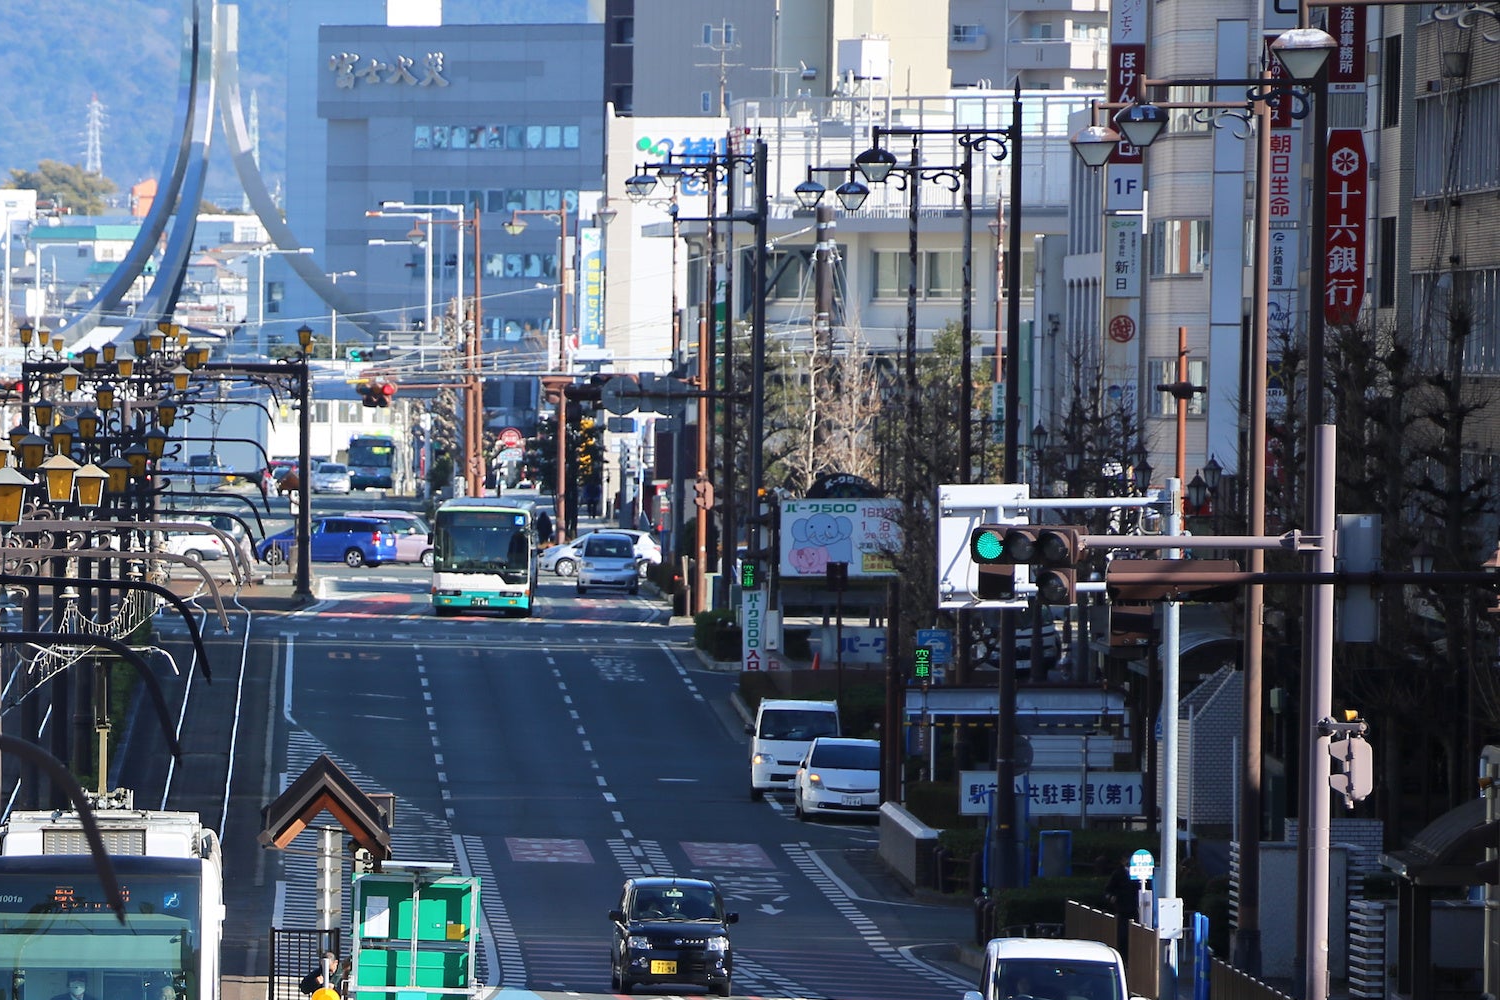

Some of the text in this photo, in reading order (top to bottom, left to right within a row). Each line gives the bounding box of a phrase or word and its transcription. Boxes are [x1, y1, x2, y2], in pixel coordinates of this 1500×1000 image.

[1339, 6, 1355, 73] 法律事務所
[328, 52, 450, 89] 富士火災
[1114, 178, 1137, 195] 1F
[1270, 134, 1292, 217] 朝日生命
[1325, 181, 1362, 306] 十六銀行
[1273, 245, 1284, 286] 扶桑電通
[785, 503, 857, 513] パーク500
[743, 564, 755, 587] 空車
[915, 648, 930, 677] 空車
